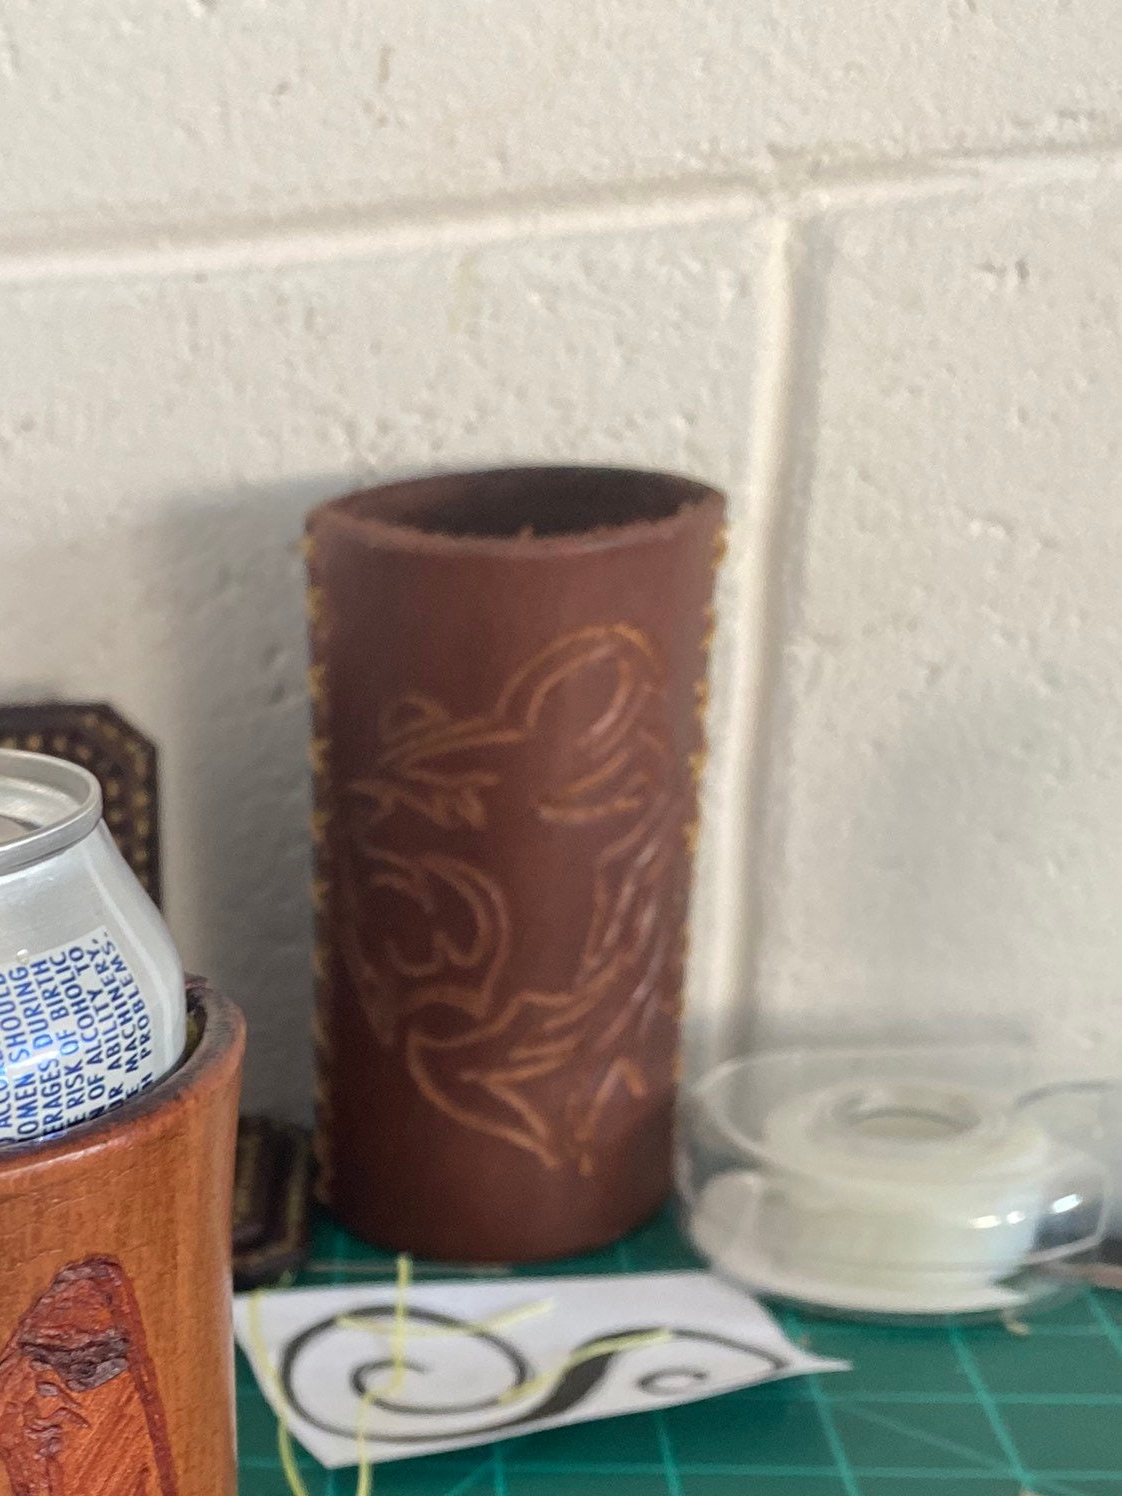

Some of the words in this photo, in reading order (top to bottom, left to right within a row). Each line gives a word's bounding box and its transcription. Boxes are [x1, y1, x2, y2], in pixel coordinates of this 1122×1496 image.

[30, 959, 69, 1021] BIRTH
[68, 946, 89, 976] TO
[8, 966, 53, 1049] DURING
[49, 951, 103, 1066] ALCOHOLIC
[86, 988, 122, 1071] ABILITY
[56, 1029, 80, 1056] OF
[14, 1072, 39, 1142] OMEN
[64, 1058, 85, 1110] RISK
[87, 1073, 105, 1101] OF
